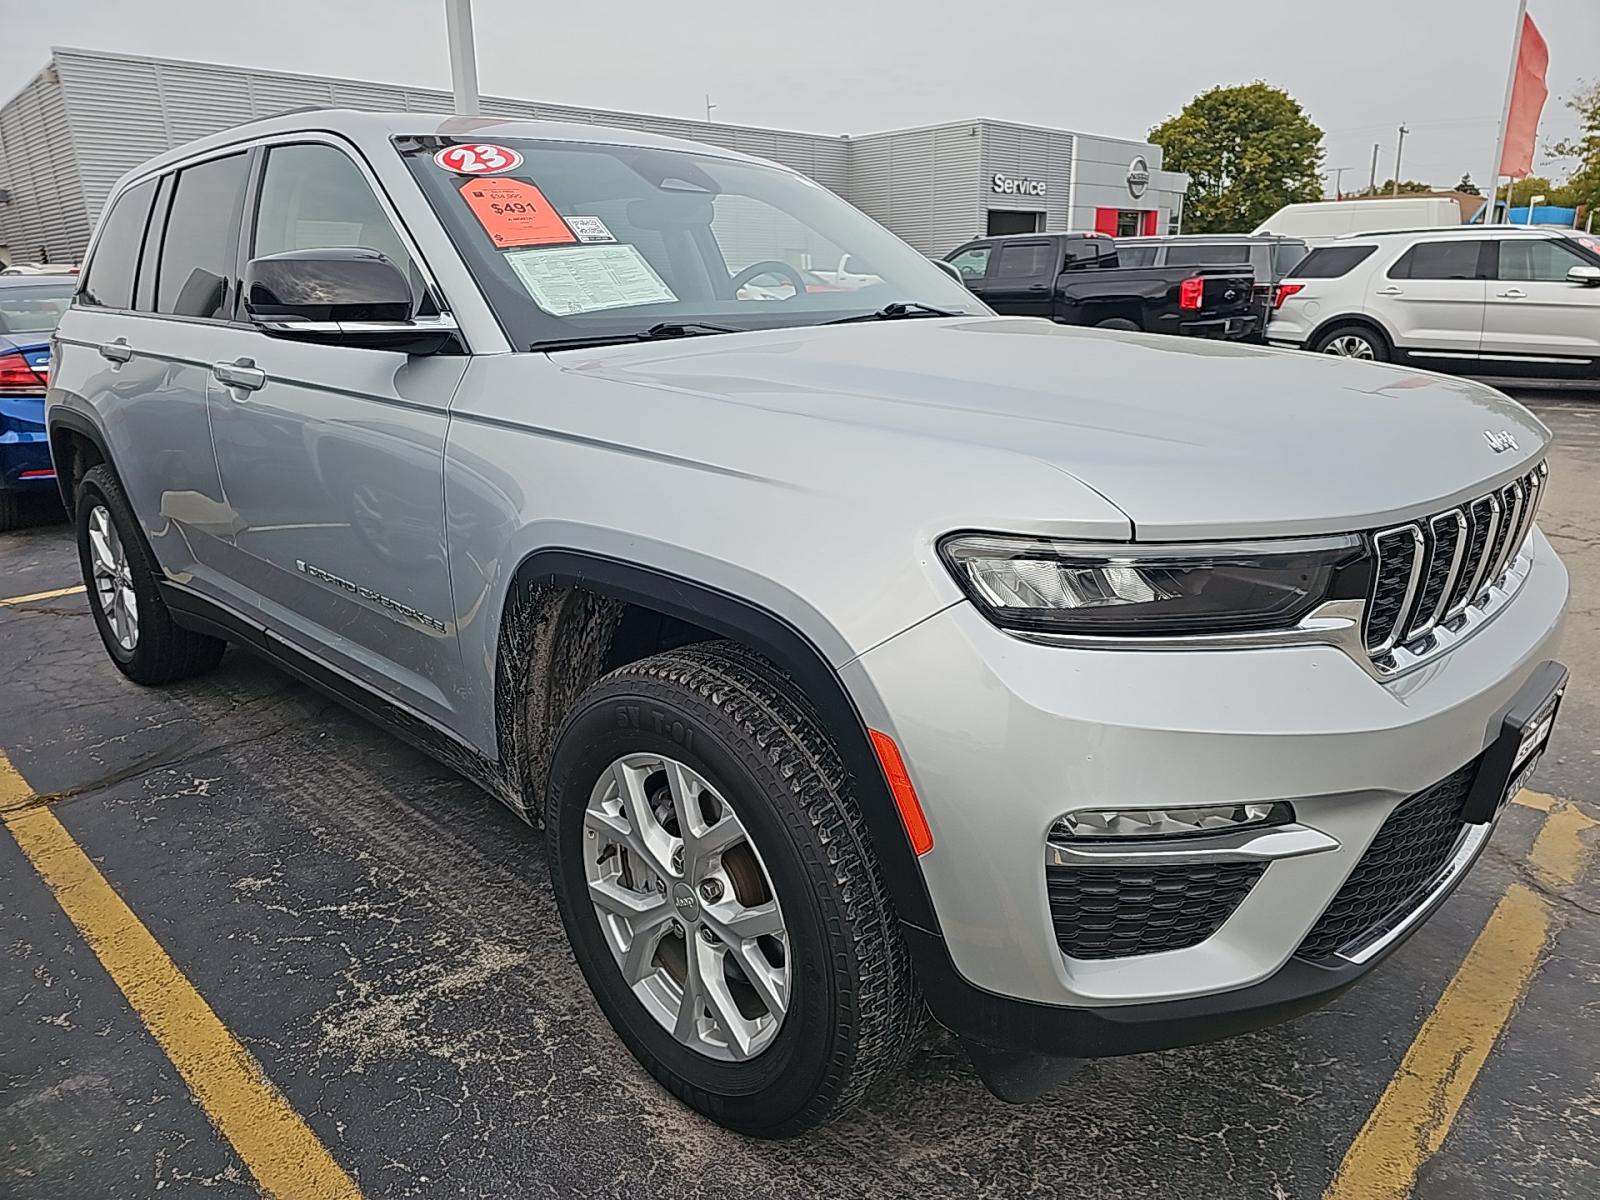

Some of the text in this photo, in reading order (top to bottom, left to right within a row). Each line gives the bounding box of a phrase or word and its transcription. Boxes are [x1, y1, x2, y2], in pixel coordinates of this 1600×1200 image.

[450, 144, 507, 171] 23
[992, 174, 1047, 196] Service
[491, 202, 537, 215] $491
